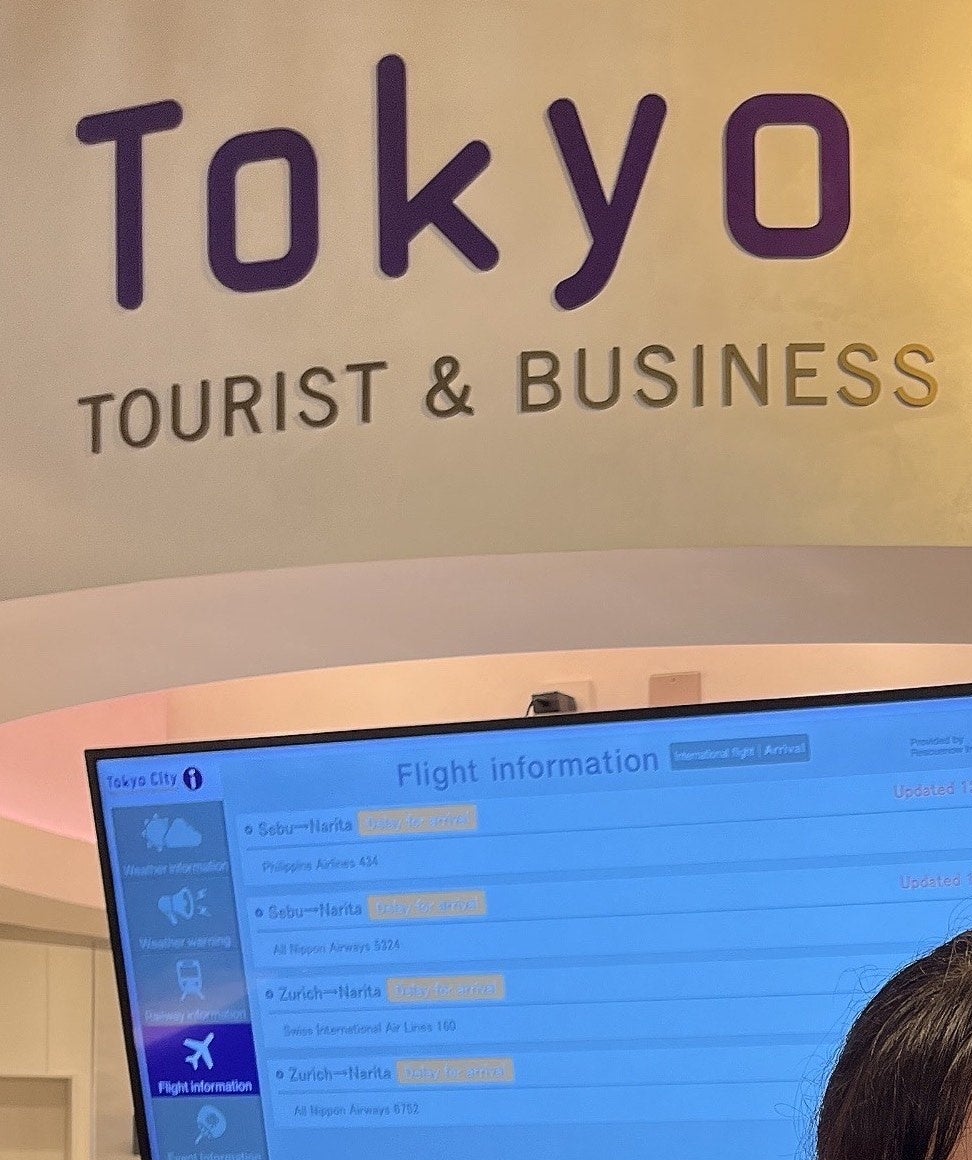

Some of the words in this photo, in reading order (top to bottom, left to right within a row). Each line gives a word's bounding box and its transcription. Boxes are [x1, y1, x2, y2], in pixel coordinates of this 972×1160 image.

[75, 53, 851, 311] Tokyo
[79, 360, 388, 454] TOURIST
[425, 354, 474, 418] &
[519, 342, 940, 414] BUSINESS
[397, 759, 478, 792] Flight
[491, 748, 659, 783] information
[106, 774, 147, 790] Tokyo
[150, 771, 178, 788] City
[894, 782, 955, 801] Updated
[900, 874, 961, 890] Updated
[158, 1080, 189, 1096] Flight
[190, 1078, 253, 1093] information
